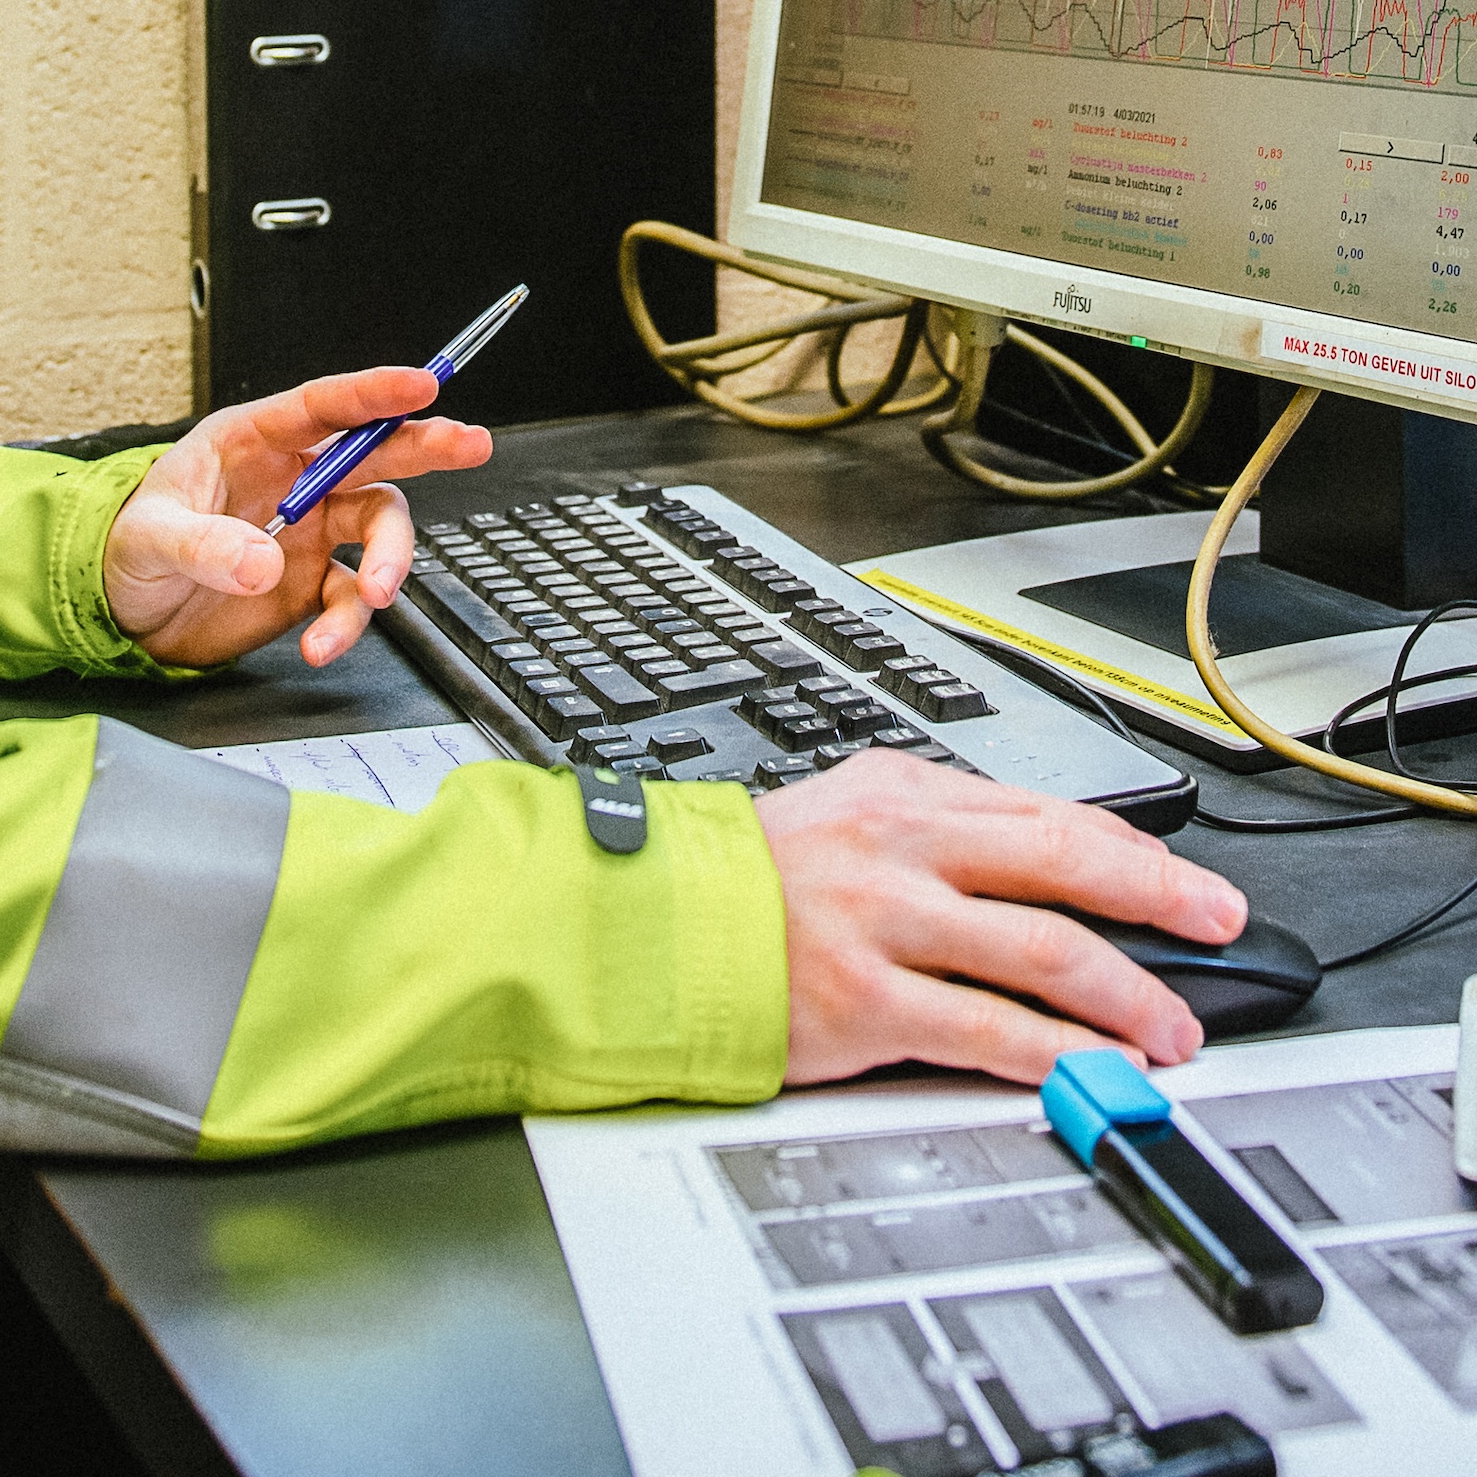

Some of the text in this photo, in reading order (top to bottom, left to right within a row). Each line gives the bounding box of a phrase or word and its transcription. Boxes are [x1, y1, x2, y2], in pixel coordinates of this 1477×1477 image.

[1112, 107, 1156, 125] 4/03/2021
[1119, 127, 1176, 147] beluchting
[1257, 146, 1283, 161] 0,83
[1345, 157, 1373, 173] 0,15
[1440, 169, 1470, 186] 2,00
[1027, 162, 1048, 177] mg/l
[1067, 168, 1111, 185] Ammonium
[1114, 175, 1171, 196] beluchting
[1252, 197, 1277, 213] 2,06
[1339, 210, 1367, 227] 0,17
[1435, 224, 1464, 242] 4,47
[1254, 180, 1267, 192] 90
[1437, 205, 1459, 221] 179
[1122, 209, 1140, 222] bb2
[1144, 213, 1179, 229] actief
[1248, 230, 1274, 247] 0,00
[1336, 245, 1364, 263] 0,00
[1431, 260, 1461, 279] 0,00
[1052, 288, 1092, 314] FUJITSU
[1107, 239, 1164, 262] beluchting
[1245, 264, 1271, 280] 0,98
[1332, 279, 1361, 298] 0,20
[1428, 296, 1457, 316] 2,26
[1283, 336, 1477, 390] MAX 25.5 TON GEVEN UIT SILO
